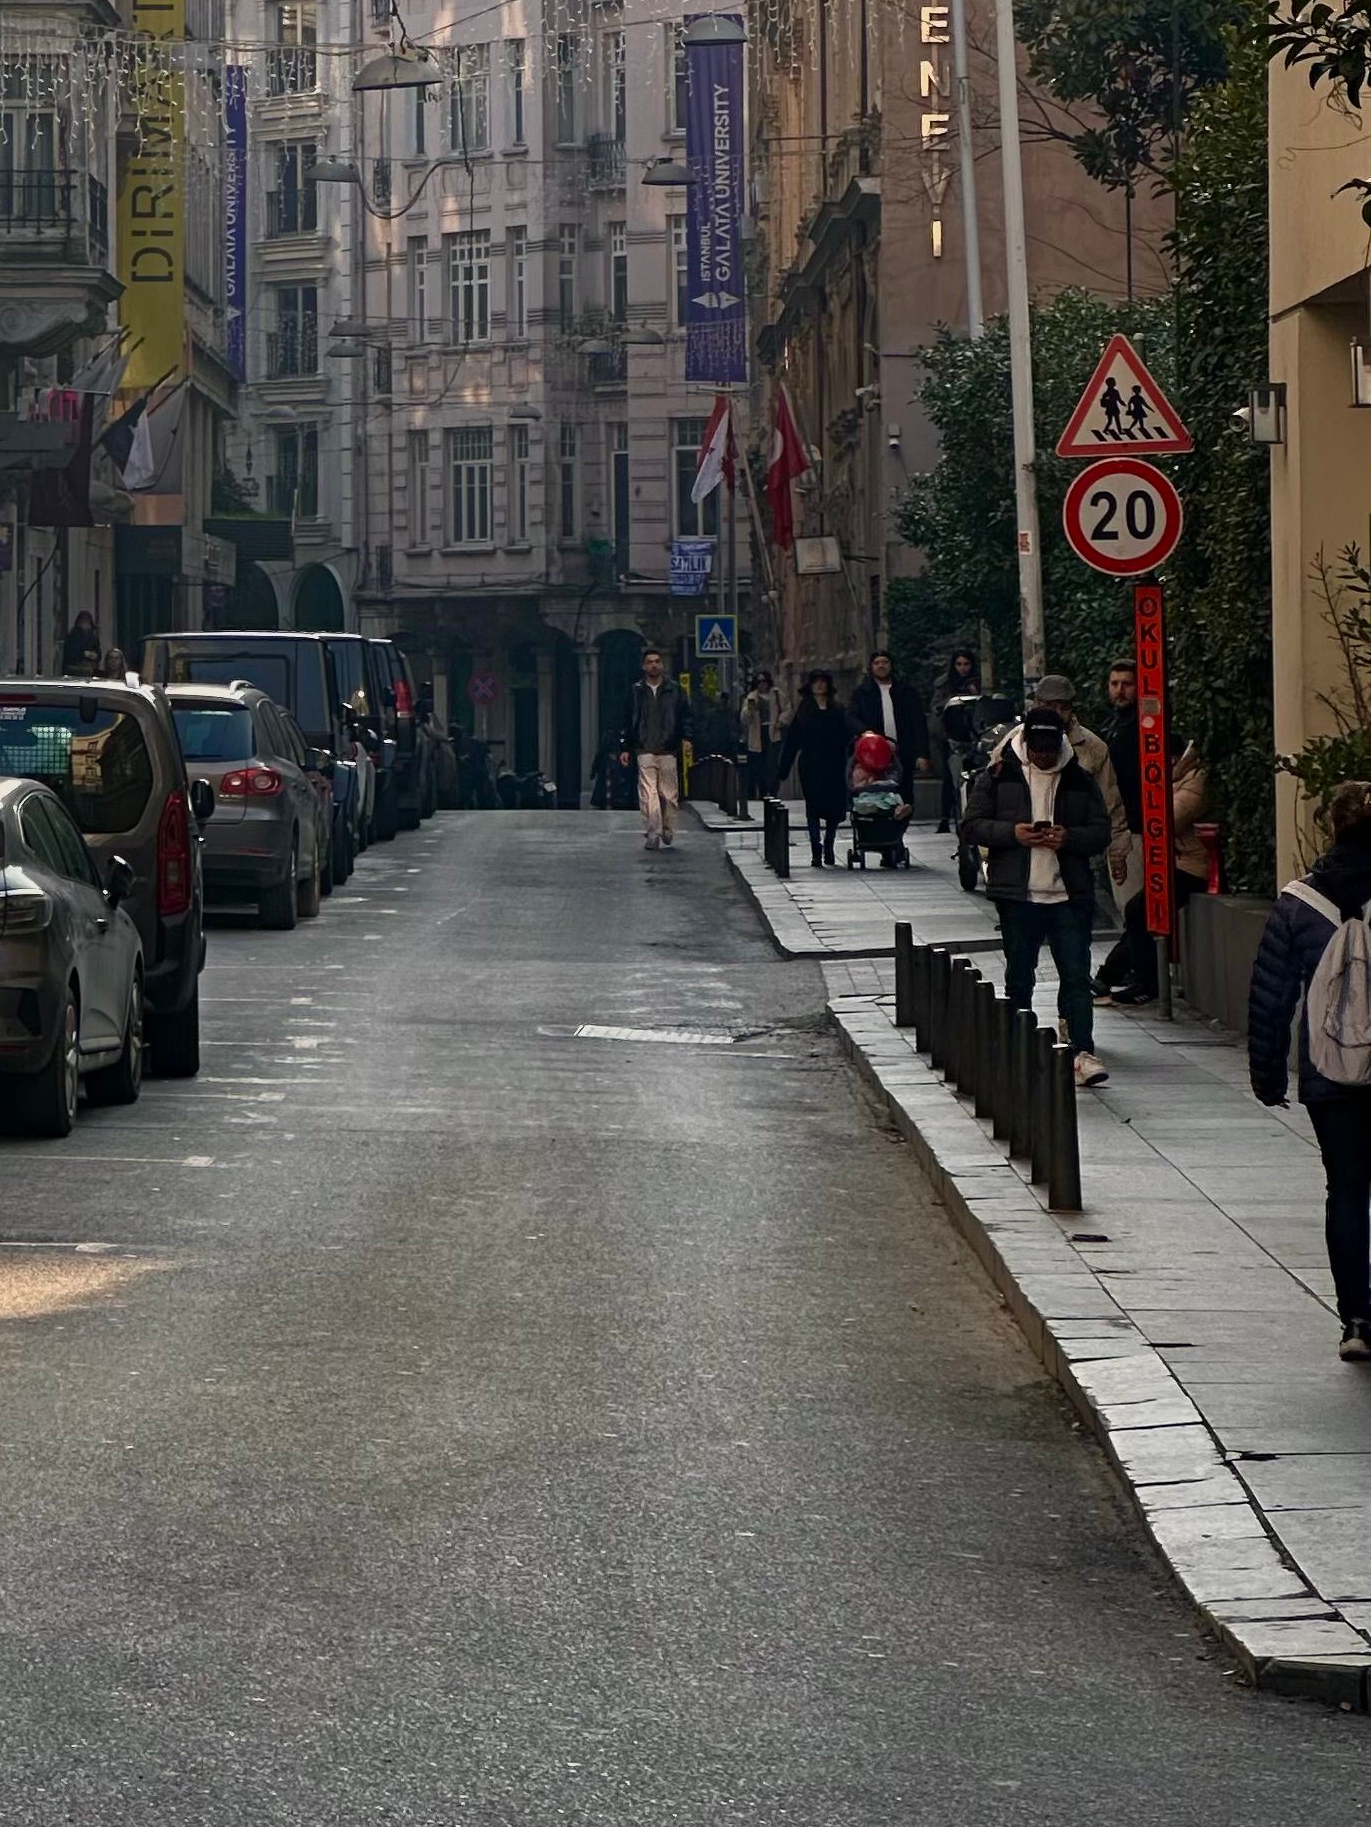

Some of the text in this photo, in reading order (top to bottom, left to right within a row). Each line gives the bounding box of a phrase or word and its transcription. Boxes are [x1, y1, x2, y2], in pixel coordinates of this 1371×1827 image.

[713, 83, 731, 282] GALATA UNIVERSITY
[1090, 489, 1155, 540] 20
[1139, 596, 1159, 696] OKUL
